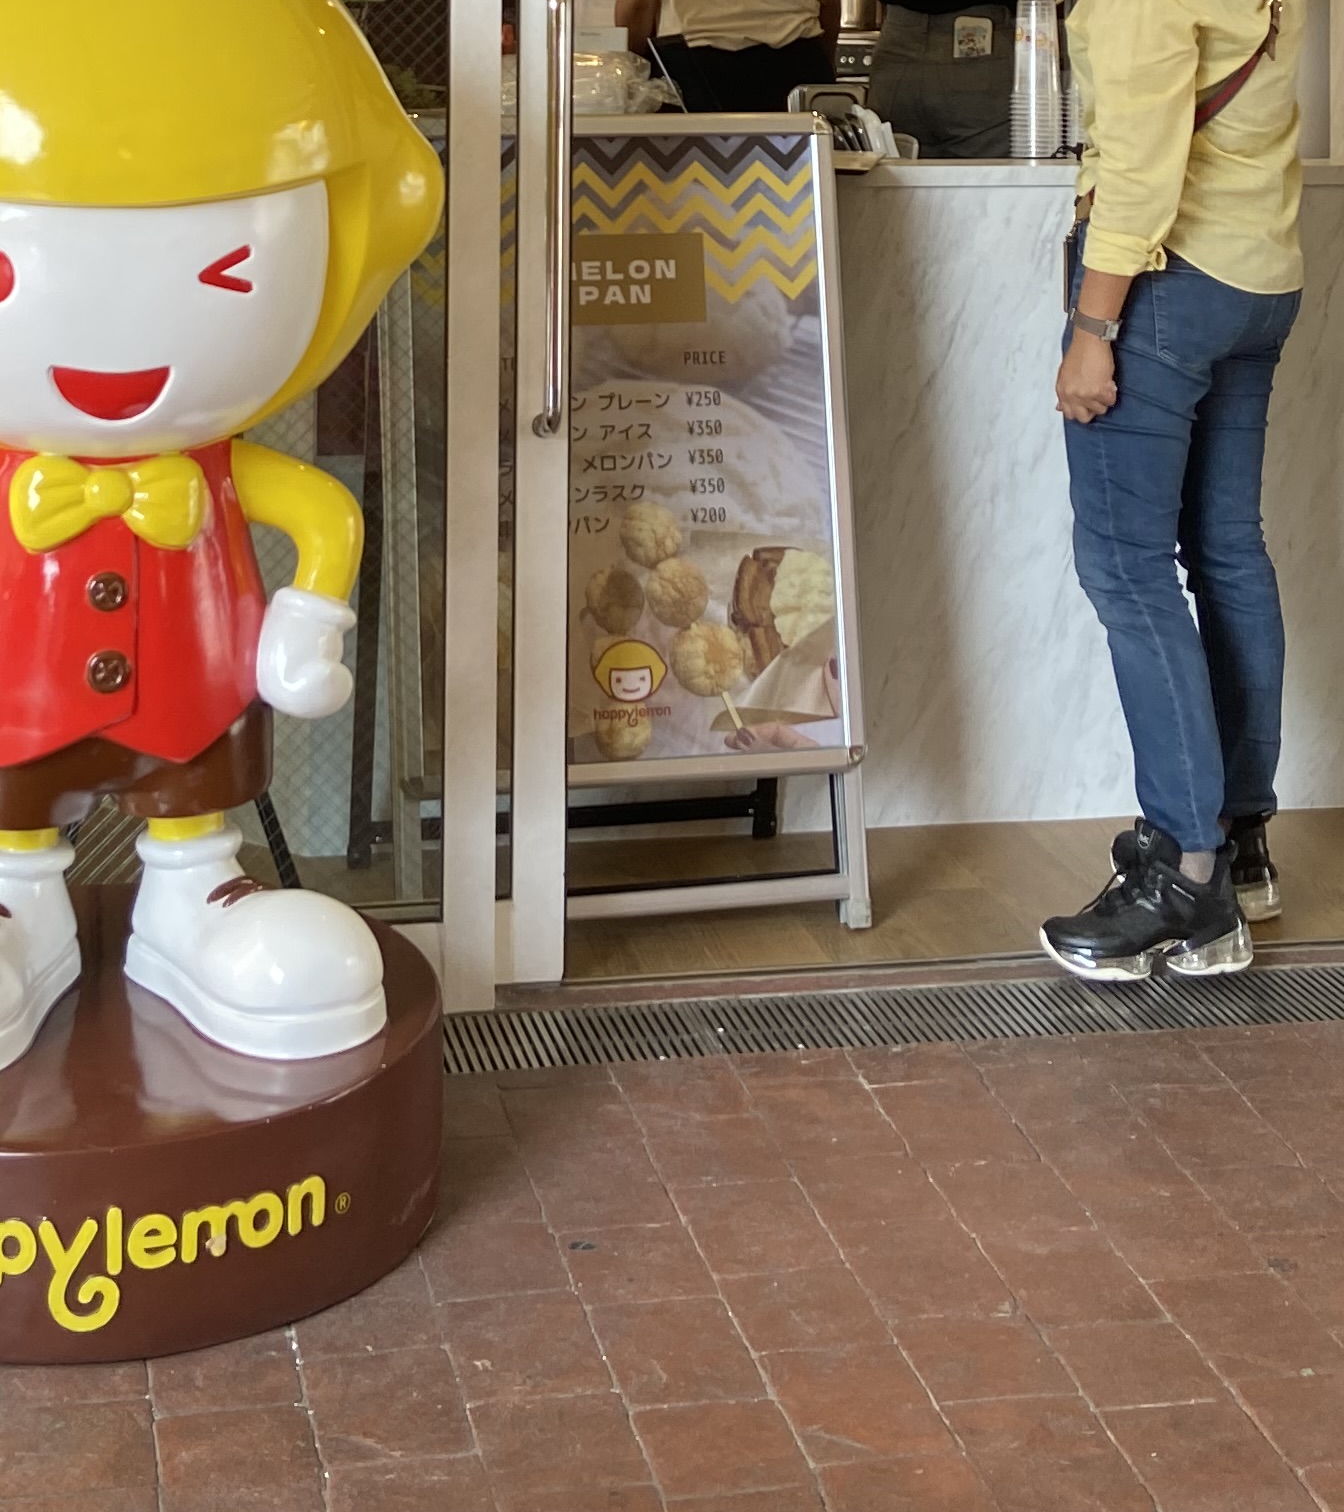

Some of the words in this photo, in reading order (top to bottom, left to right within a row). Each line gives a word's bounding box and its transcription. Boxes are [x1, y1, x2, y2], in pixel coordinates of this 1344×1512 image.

[572, 259, 676, 281] ELON
[579, 284, 651, 305] PAN
[683, 351, 726, 365] PRICE
[598, 392, 670, 411] プレーン
[685, 391, 721, 406] ¥250
[599, 423, 652, 440] アイス
[687, 419, 722, 436] ¥350
[582, 452, 672, 472] メロンパン
[688, 448, 724, 465] ¥350
[689, 477, 725, 494] ¥350
[690, 507, 726, 523] ¥200
[593, 704, 672, 727] happylemon
